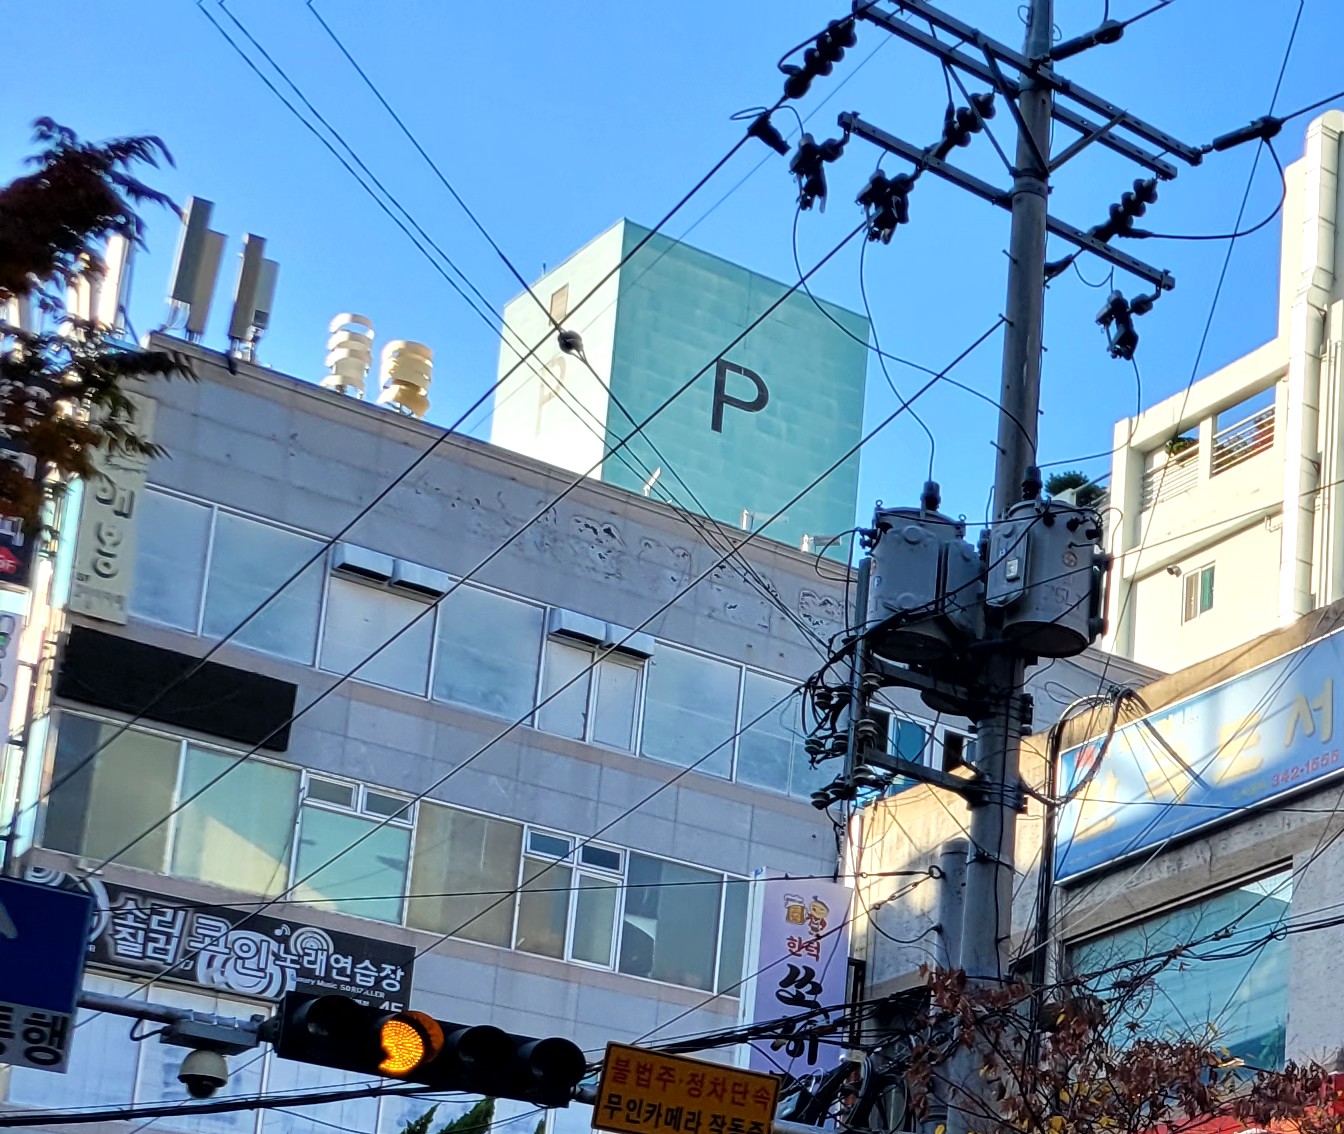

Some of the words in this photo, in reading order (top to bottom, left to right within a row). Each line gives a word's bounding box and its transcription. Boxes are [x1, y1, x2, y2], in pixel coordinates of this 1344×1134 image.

[711, 358, 769, 434] P
[1272, 749, 1341, 789] 342-1555
[115, 898, 188, 937] 소리
[115, 926, 183, 966] 질러
[188, 914, 271, 976] 코인
[276, 942, 405, 993] 노래연습장
